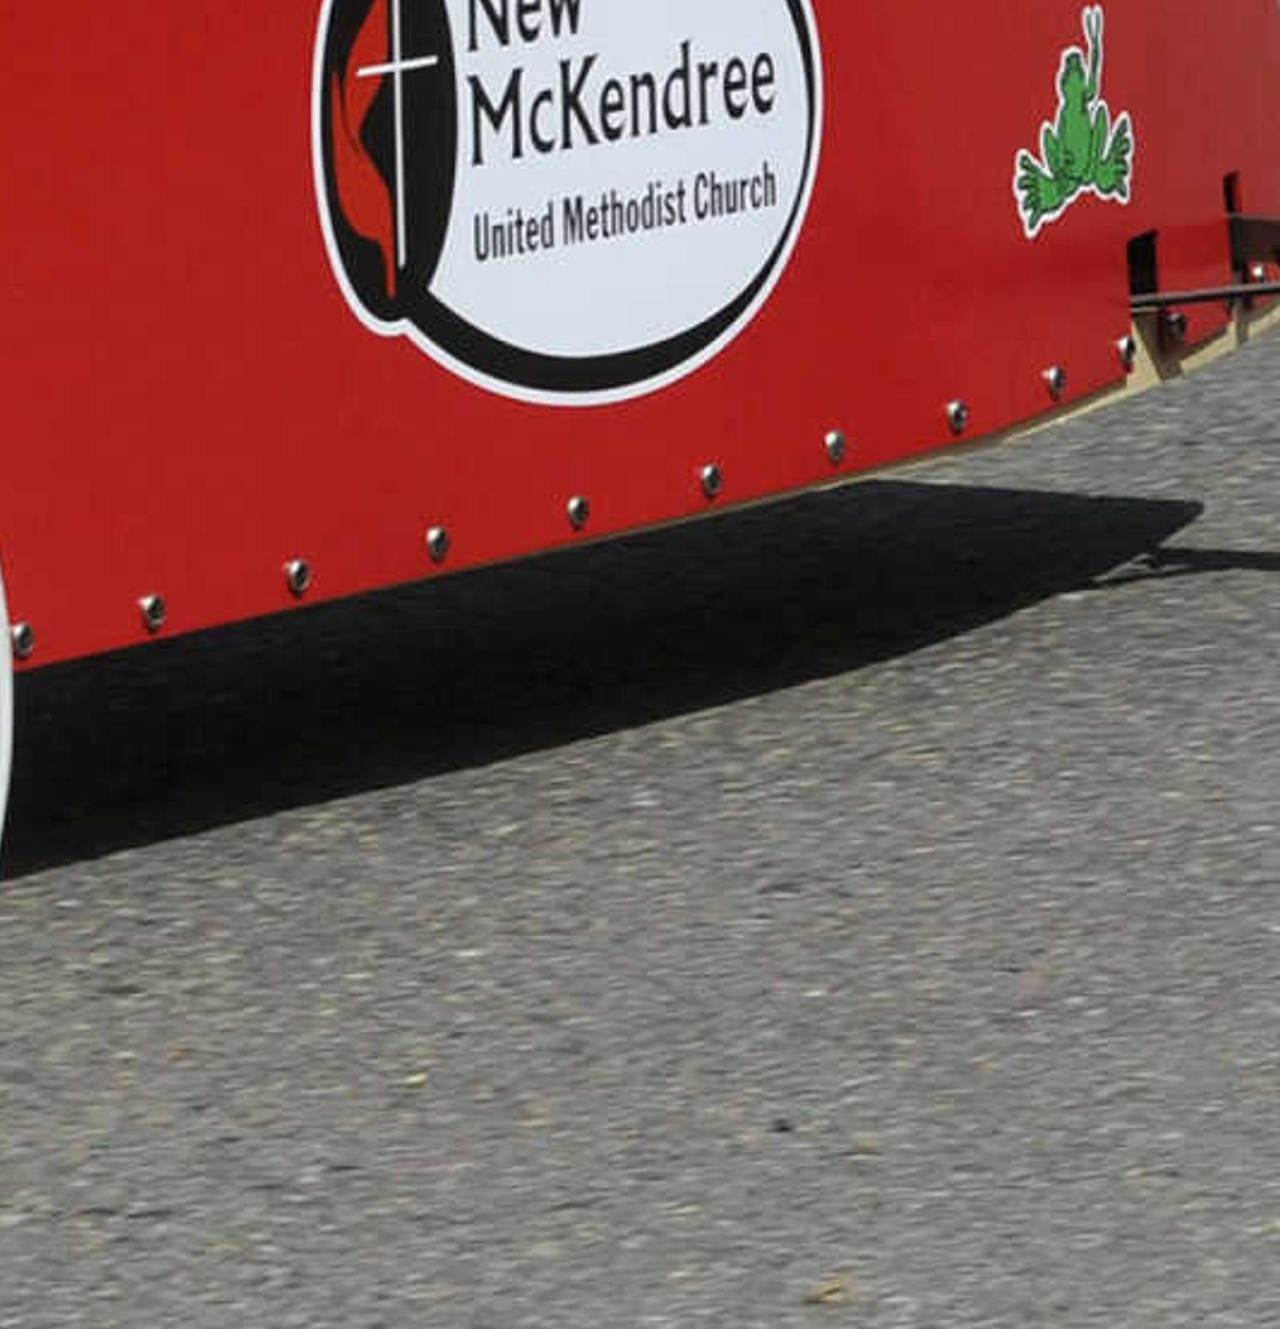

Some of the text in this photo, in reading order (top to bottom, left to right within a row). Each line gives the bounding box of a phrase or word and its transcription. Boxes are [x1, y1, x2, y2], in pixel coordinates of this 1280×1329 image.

[467, 40, 776, 167] McKendree
[474, 161, 778, 262] United Methodist Church
